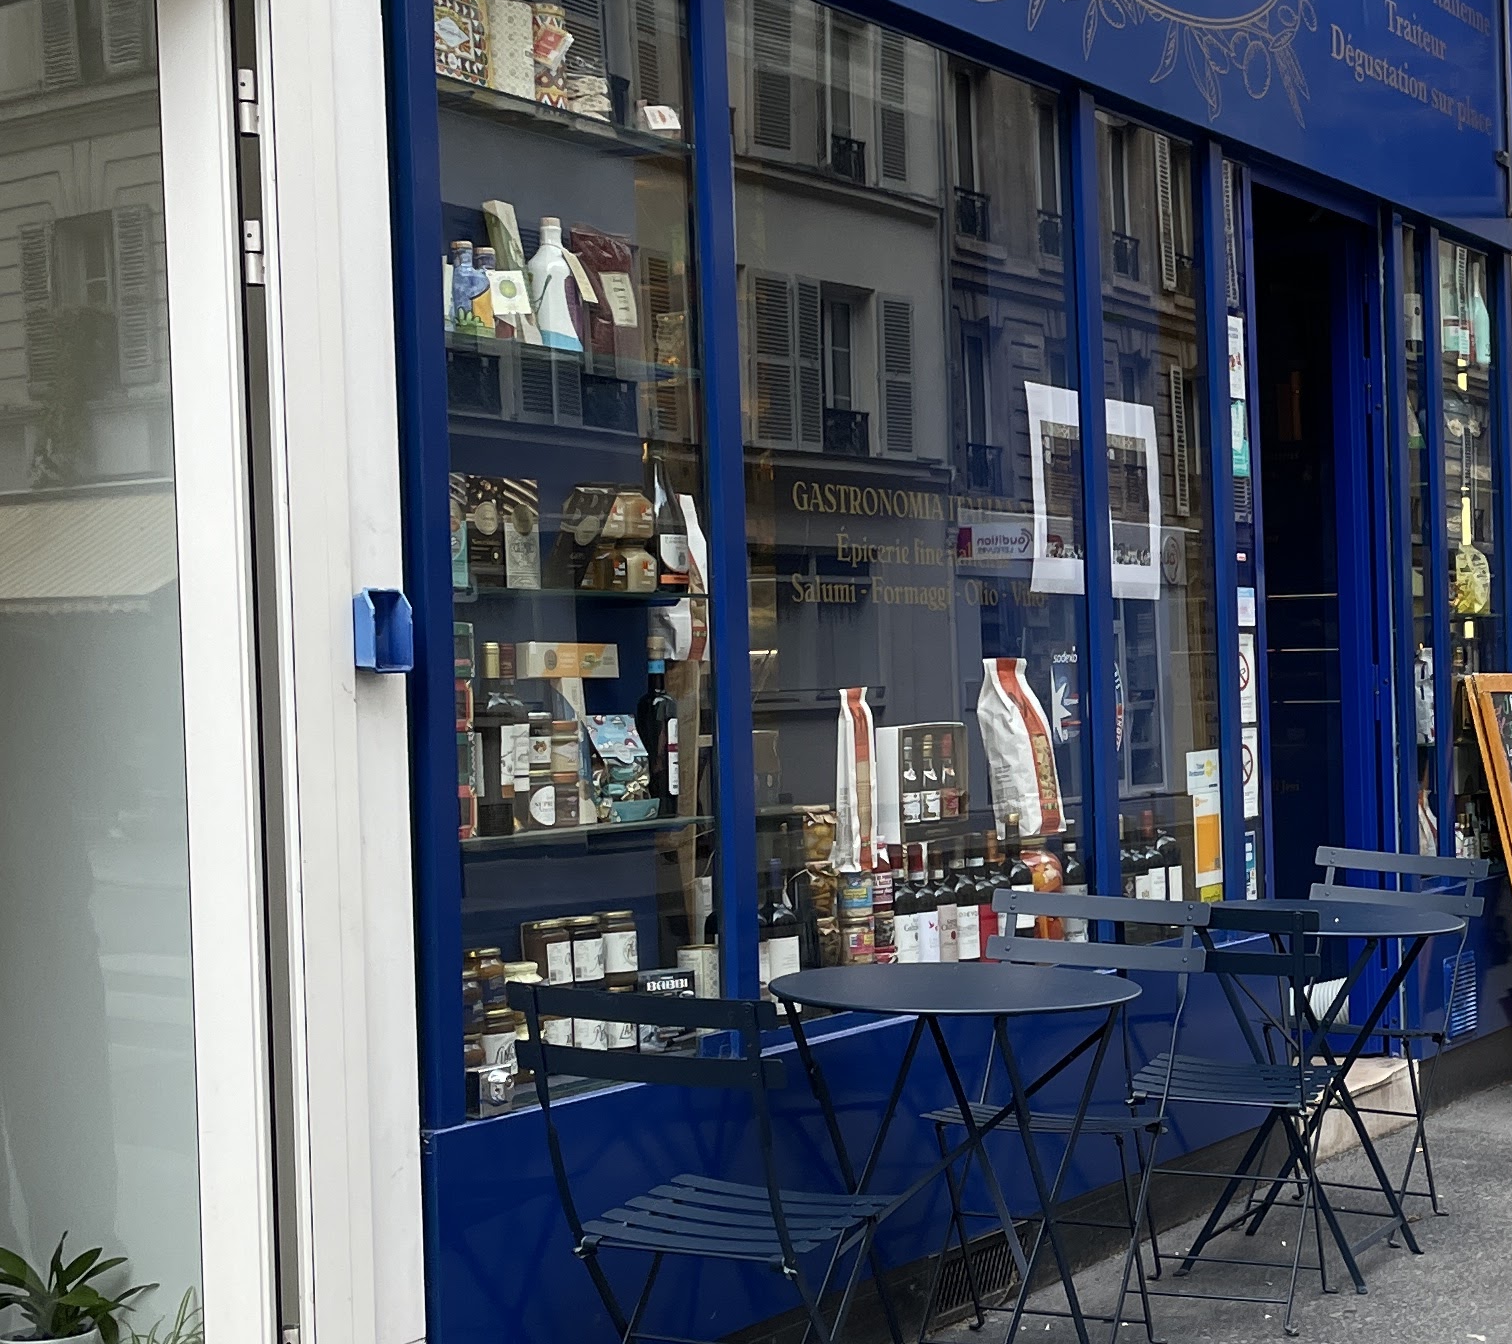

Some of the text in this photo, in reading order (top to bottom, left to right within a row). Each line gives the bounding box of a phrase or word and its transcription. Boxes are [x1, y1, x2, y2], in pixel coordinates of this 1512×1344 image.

[1330, 22, 1493, 136] Dégustation sur place
[791, 480, 945, 521] GASTRONOMIA
[835, 525, 910, 568] Épicerie
[790, 573, 857, 604] Salumi
[871, 575, 951, 611] Formaggi
[964, 579, 999, 607] Olio
